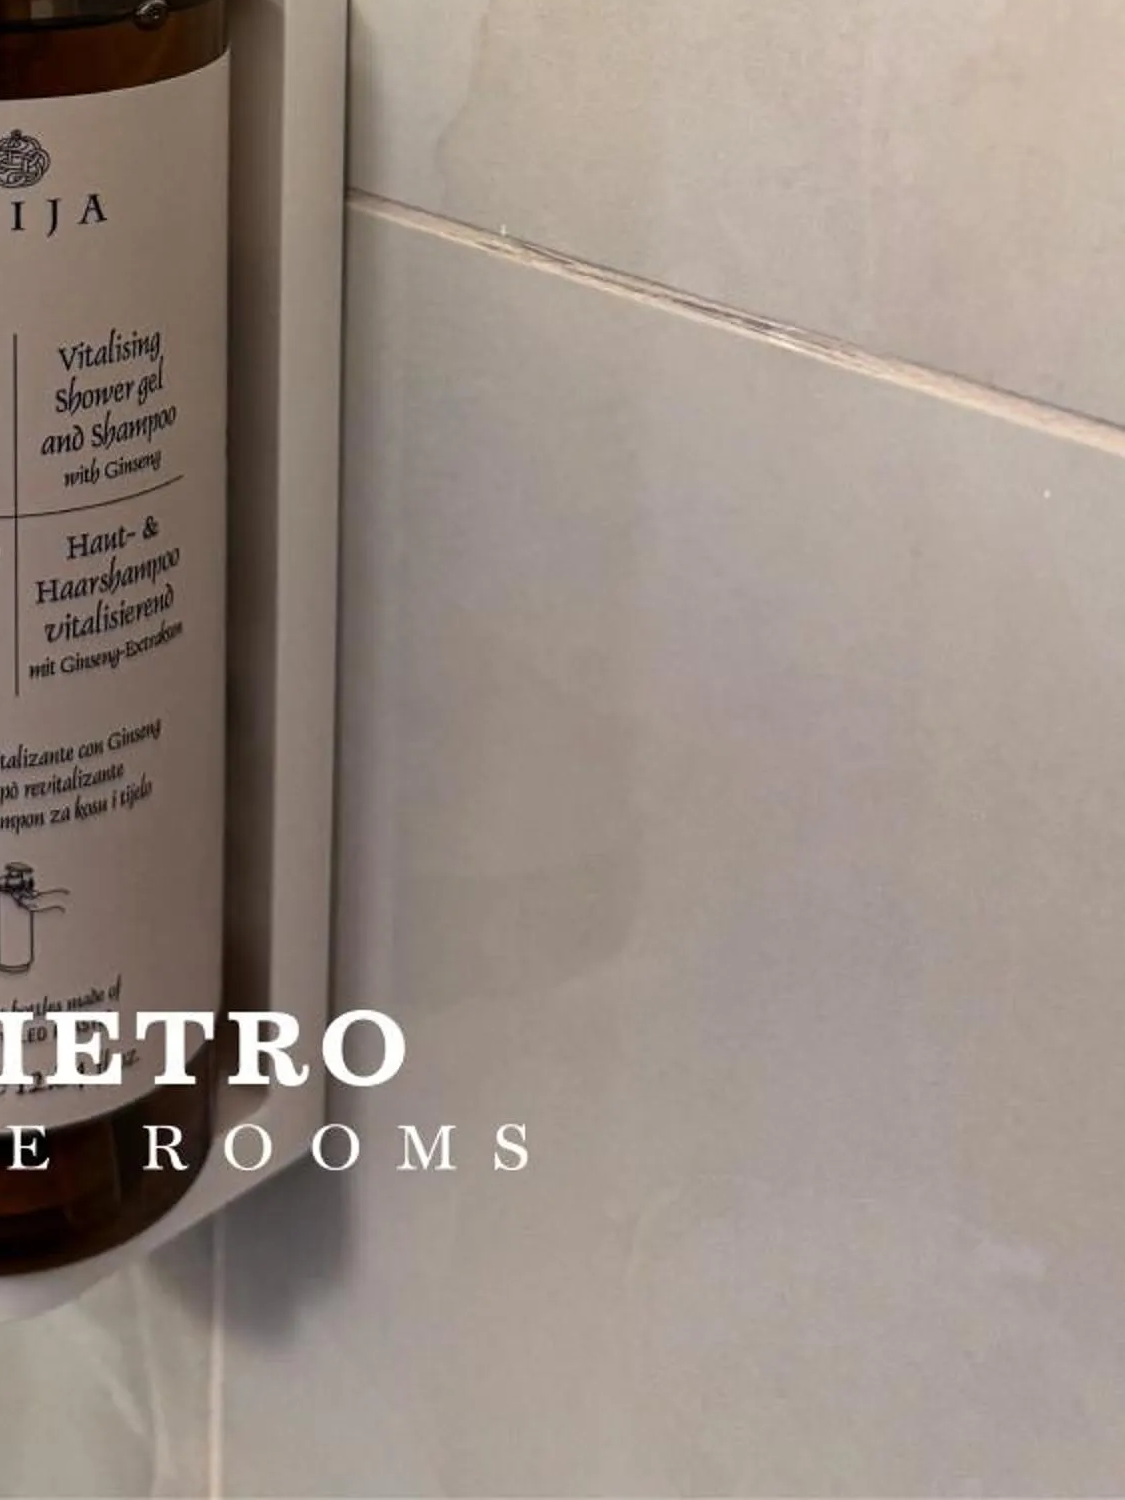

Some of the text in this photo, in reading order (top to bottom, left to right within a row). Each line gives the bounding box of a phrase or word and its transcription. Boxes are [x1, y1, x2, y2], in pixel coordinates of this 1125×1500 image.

[58, 328, 162, 372] Vitalising
[55, 356, 164, 416] Shower gel
[41, 405, 178, 455] and Shampoo
[64, 450, 162, 488] with Ginseng
[66, 515, 160, 560] Haut- &
[35, 548, 181, 605] Haarshampoo
[44, 583, 175, 643] vitalisierend
[29, 657, 56, 679] mit
[78, 745, 104, 760] con
[107, 718, 162, 751] Ginseng
[25, 763, 124, 797] revitalizante
[50, 807, 71, 825] za
[111, 790, 118, 810] i
